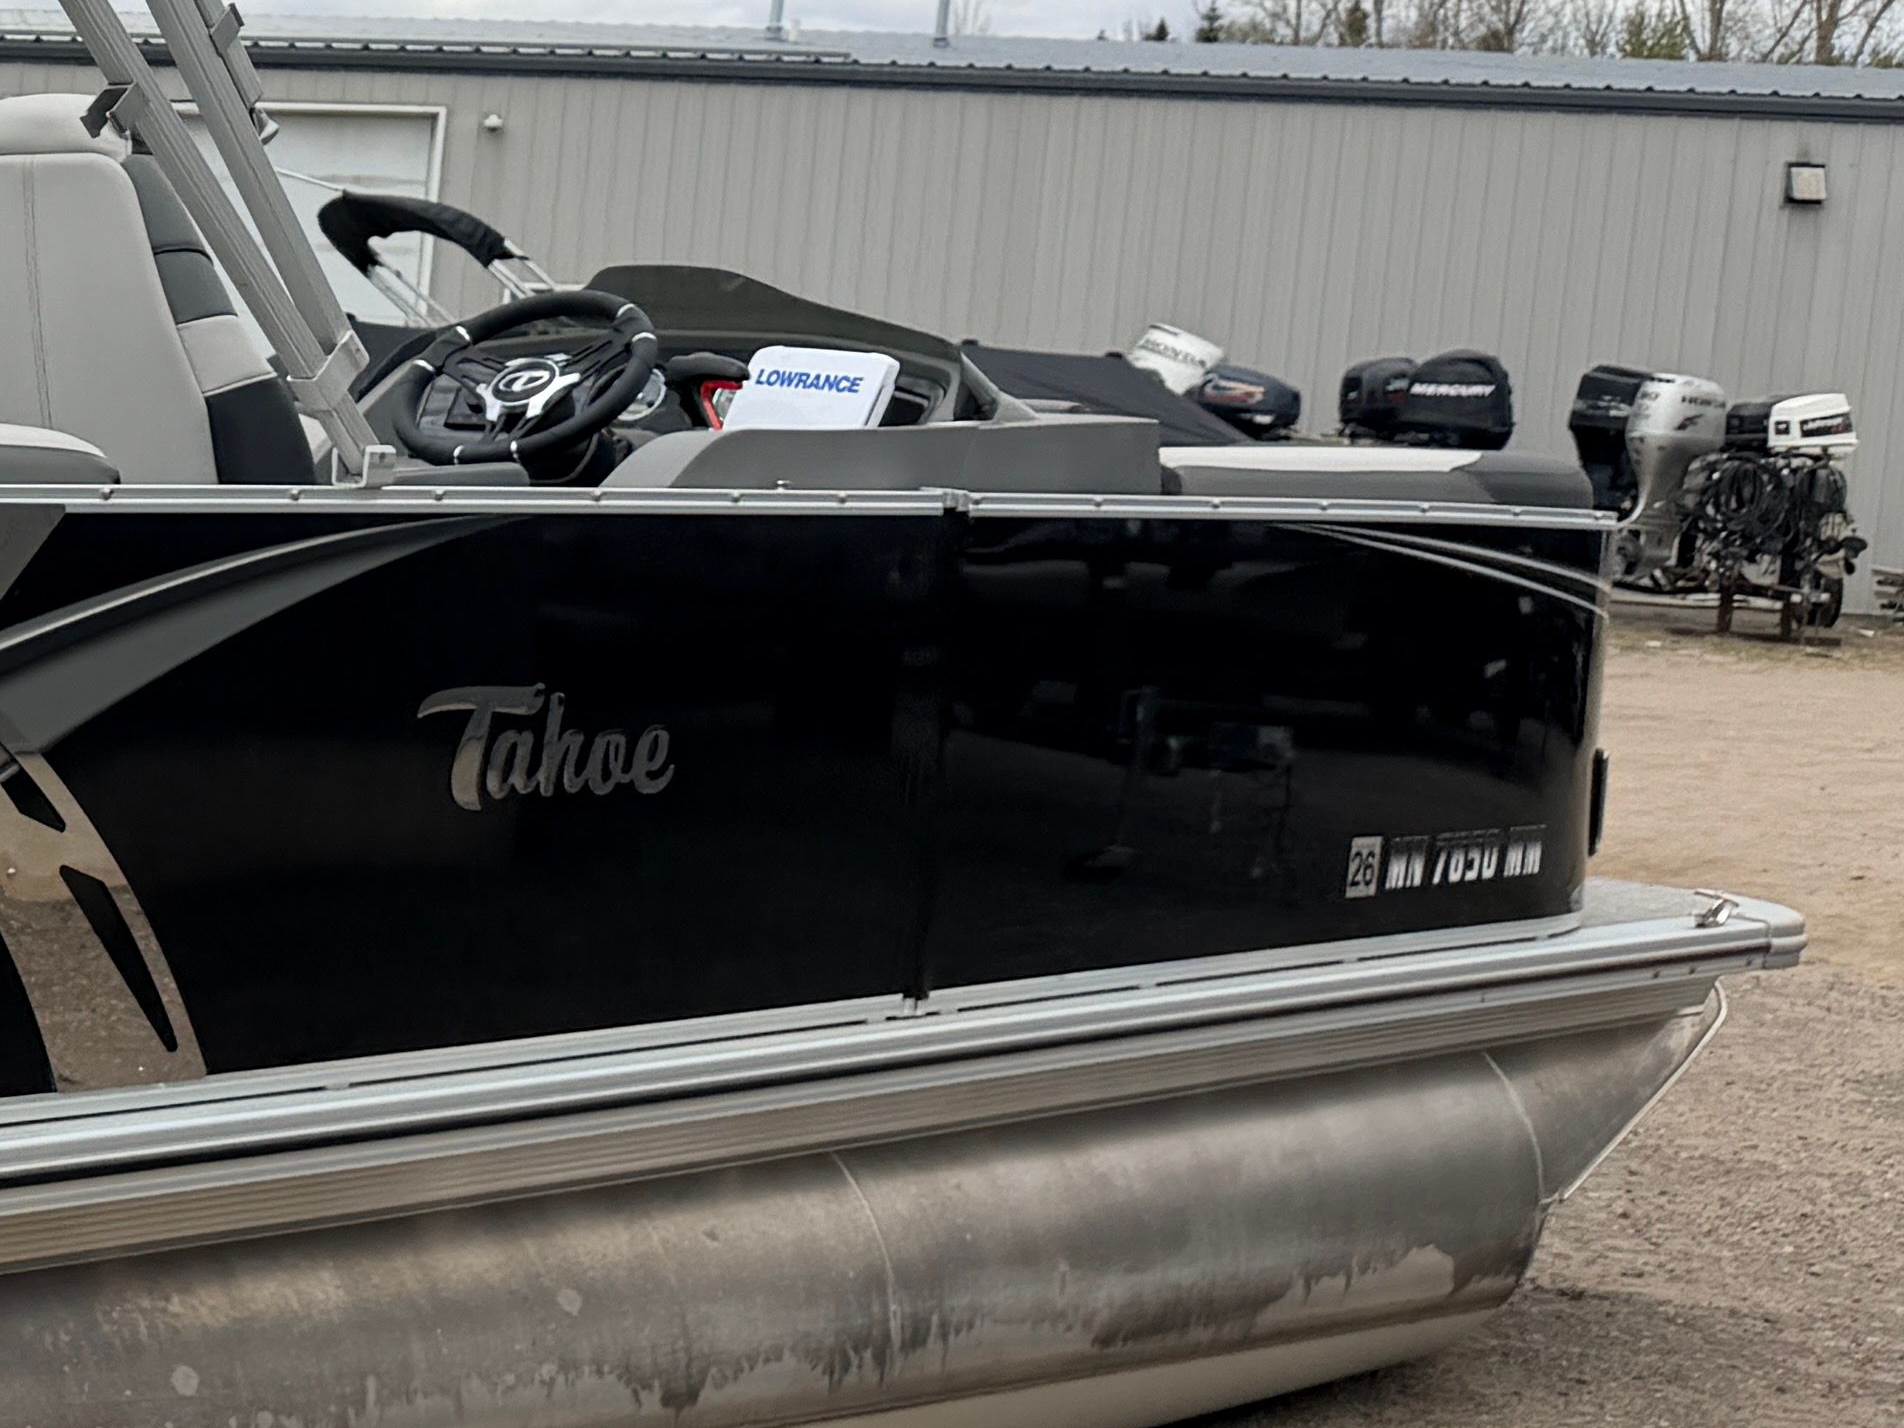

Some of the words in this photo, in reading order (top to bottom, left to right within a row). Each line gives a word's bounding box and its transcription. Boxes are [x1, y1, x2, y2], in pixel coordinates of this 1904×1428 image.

[755, 369, 864, 393] LOWRANCE
[417, 682, 675, 811] Tahoe
[1349, 851, 1375, 888] 26
